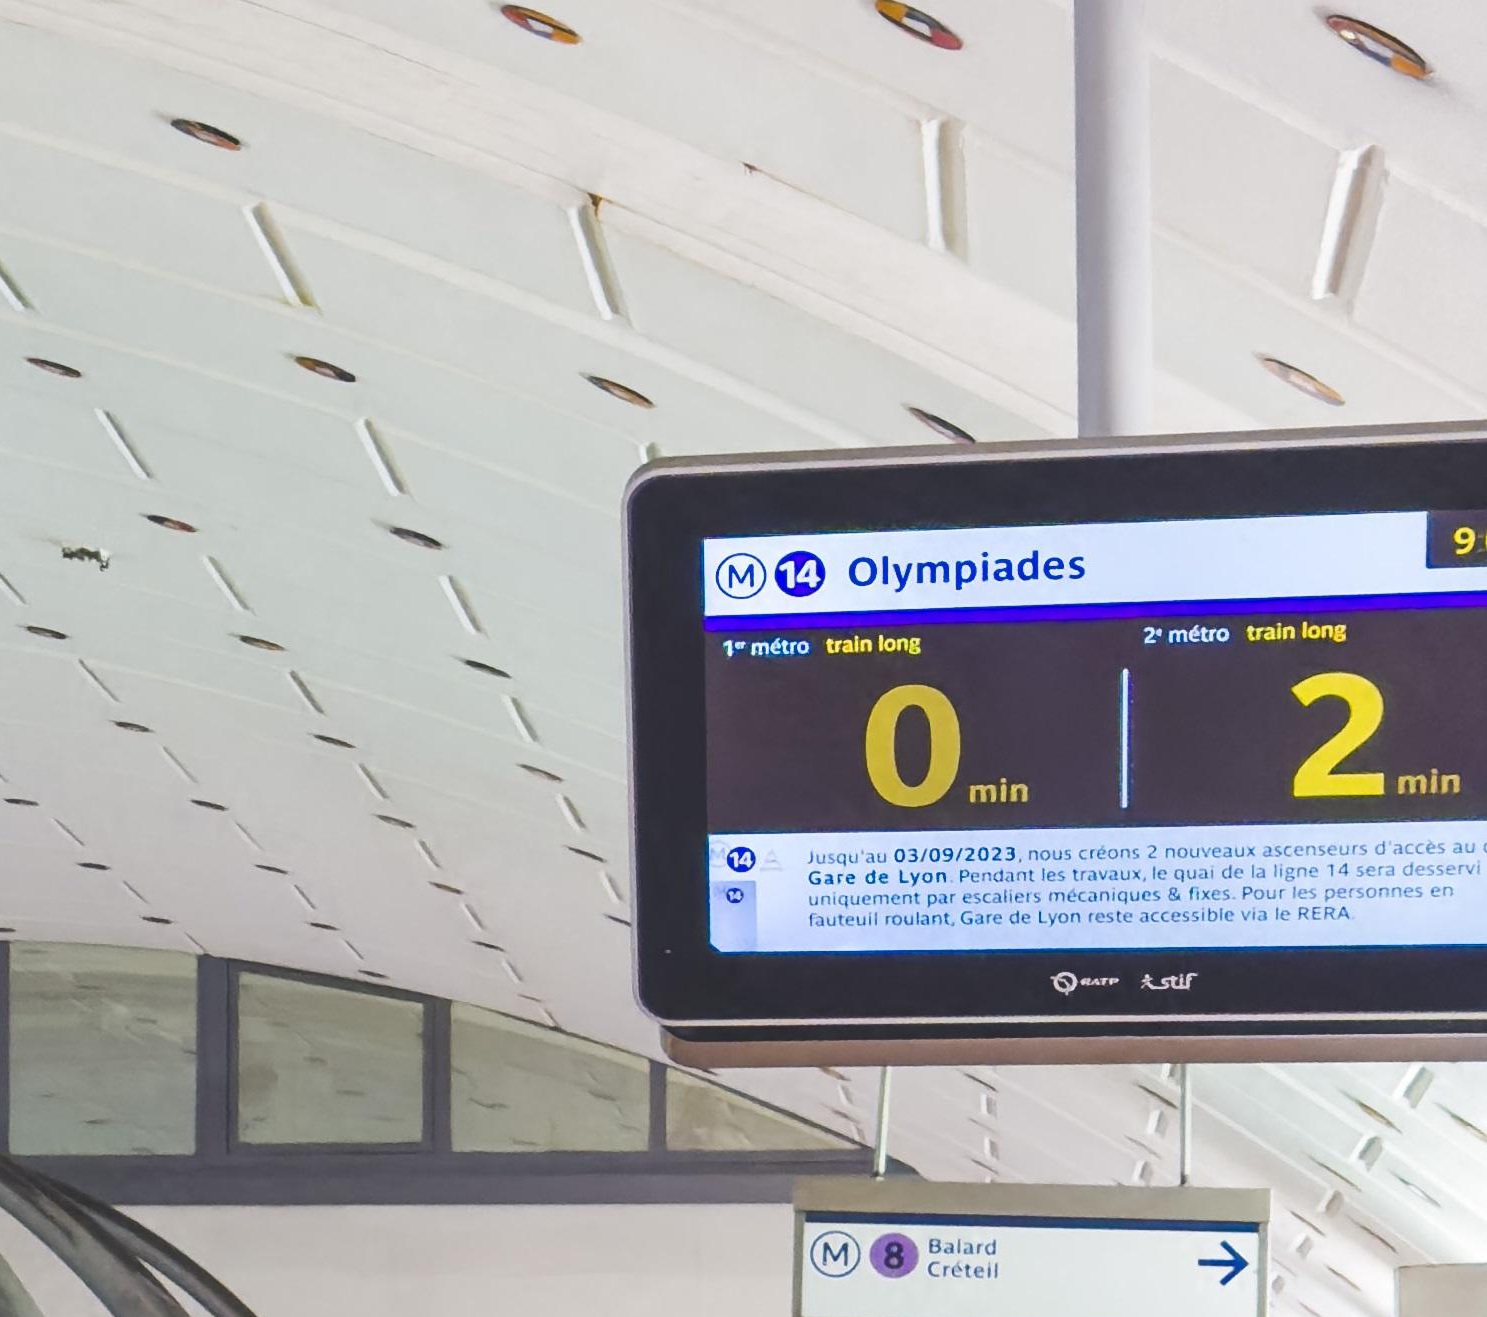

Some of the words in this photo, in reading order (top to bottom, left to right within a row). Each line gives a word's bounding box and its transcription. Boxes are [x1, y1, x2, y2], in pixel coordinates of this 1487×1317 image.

[778, 560, 822, 589] 14
[848, 550, 1086, 593] Olympiades
[1168, 624, 1230, 644] métro
[1246, 622, 1295, 642] train
[1301, 621, 1347, 643] long
[750, 636, 810, 656] métro
[826, 635, 873, 655] train
[877, 634, 922, 655] long
[865, 684, 961, 808] 0
[969, 778, 1029, 804] min
[1290, 671, 1385, 797] 2
[1397, 768, 1461, 795] min
[808, 849, 887, 867] Jusqu'au
[894, 846, 1022, 864] 03/09/2023,
[1028, 849, 1071, 862] nous
[1078, 845, 1139, 861] créons
[1147, 845, 1157, 859] 2
[1165, 845, 1255, 860] nouveaux
[1263, 843, 1368, 857] ascenseurs
[1374, 840, 1446, 856] d'accès
[1452, 842, 1475, 854] au
[808, 870, 856, 886] Gare
[865, 869, 889, 885] de
[959, 868, 1034, 884] Pendant
[1041, 868, 1065, 883] les
[1072, 866, 1147, 882] travaux,
[1152, 866, 1166, 880] le
[1174, 865, 1215, 883] quai
[1221, 865, 1243, 880] de
[1251, 865, 1266, 879] la
[1273, 864, 1319, 882] ligne
[1326, 863, 1349, 878] 14
[1356, 865, 1395, 878] sera
[1402, 861, 1481, 877] desservi
[808, 891, 920, 908] uniquement
[926, 892, 956, 908] par
[962, 888, 1041, 905] escaliers
[1048, 887, 1161, 906] mécaniques
[1168, 887, 1181, 901] &
[1189, 886, 1236, 901] fixes.
[1242, 886, 1284, 900] Pour
[1292, 885, 1316, 900] les
[1324, 886, 1423, 902] personnes
[1430, 884, 1454, 898] en
[808, 911, 878, 927] fauteuil
[885, 911, 955, 927] roulant,
[960, 911, 1003, 925] Gare
[1009, 910, 1031, 925] de
[1038, 910, 1082, 928] Lyon
[1088, 910, 1133, 924] reste
[1139, 907, 1234, 923] accessible
[1240, 907, 1267, 922] via
[1275, 907, 1290, 921] le
[1079, 976, 1120, 987] RATP
[883, 1240, 905, 1270] 8
[928, 1238, 997, 1256] Balard
[927, 1260, 998, 1279] Créteil
